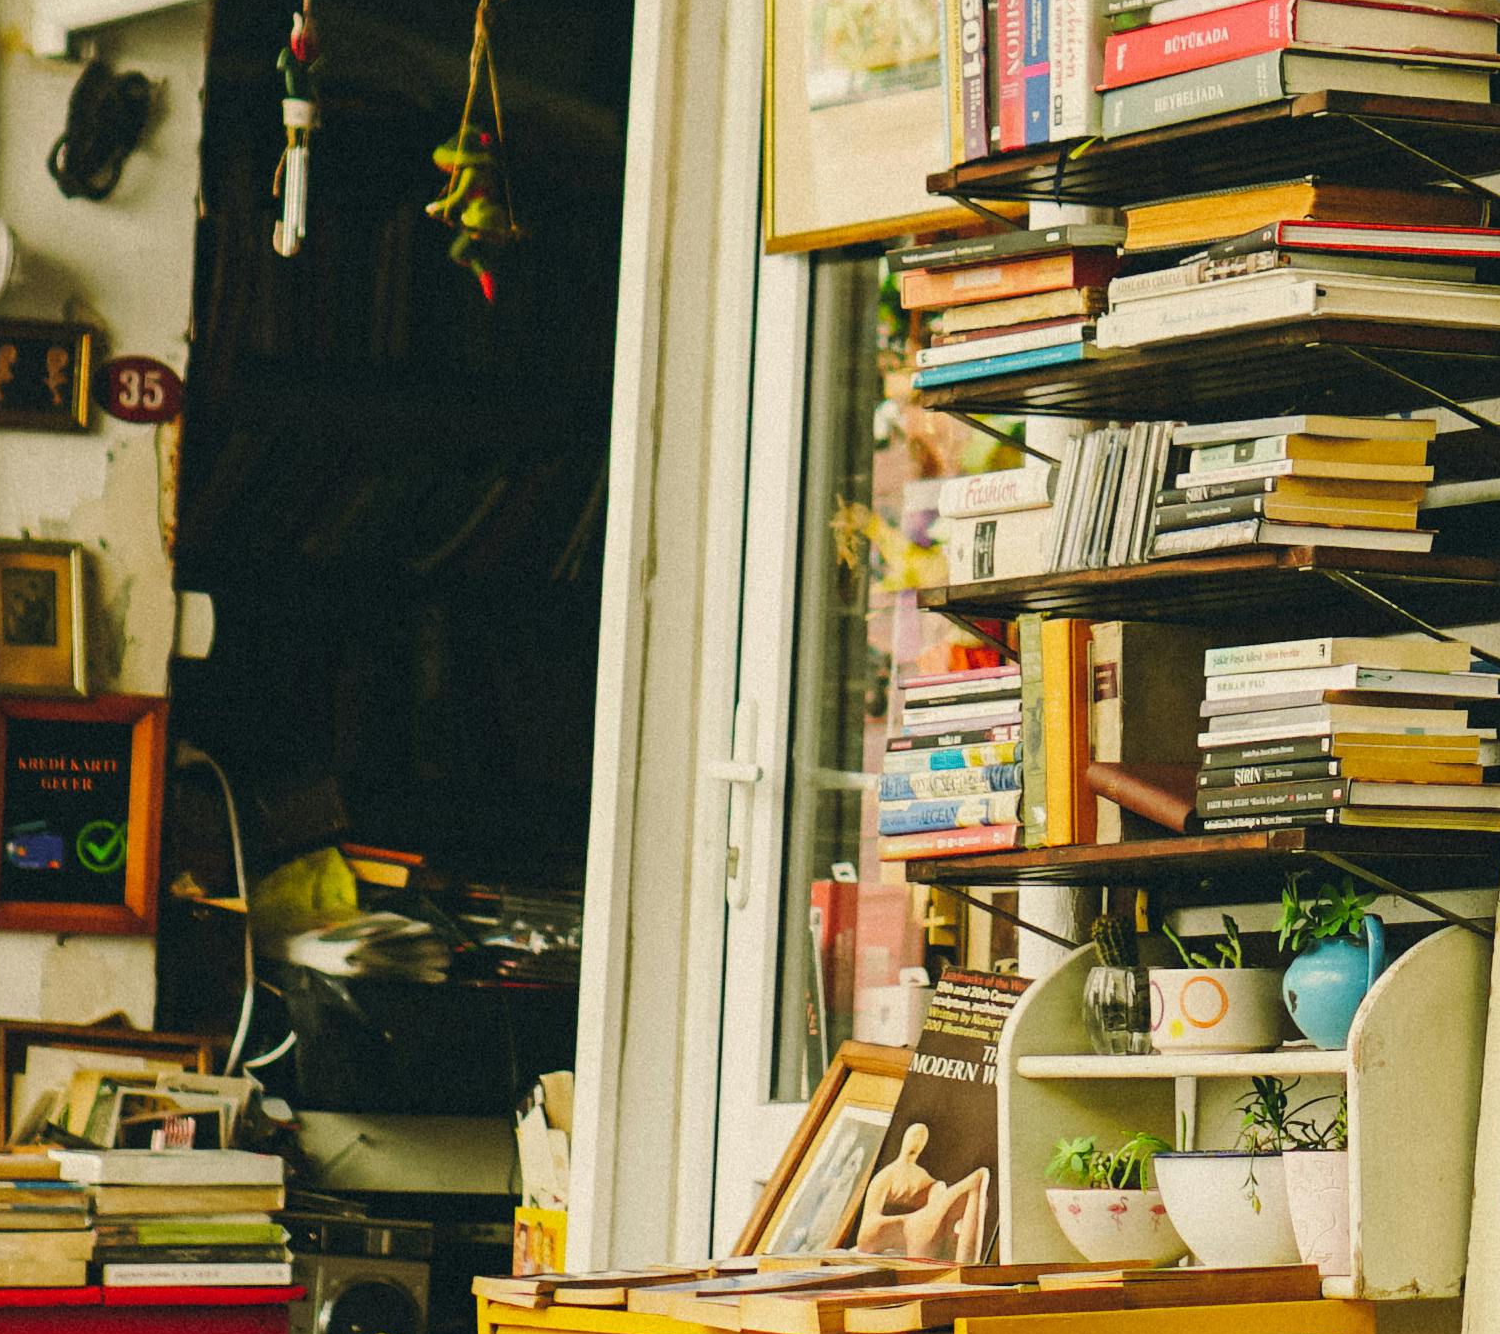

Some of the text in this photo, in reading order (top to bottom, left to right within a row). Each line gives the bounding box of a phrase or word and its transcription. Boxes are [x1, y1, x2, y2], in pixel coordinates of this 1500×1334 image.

[1163, 27, 1230, 55] BÜYÜKADA
[1153, 83, 1225, 113] HEYBELİADA
[117, 369, 164, 411] 35
[965, 477, 1018, 509] Fashion
[954, 985, 970, 996] and
[970, 985, 990, 999] 20th
[986, 976, 994, 987] of
[928, 1006, 960, 1022] Written
[960, 1012, 972, 1025] by
[908, 1052, 980, 1082] MODERN
